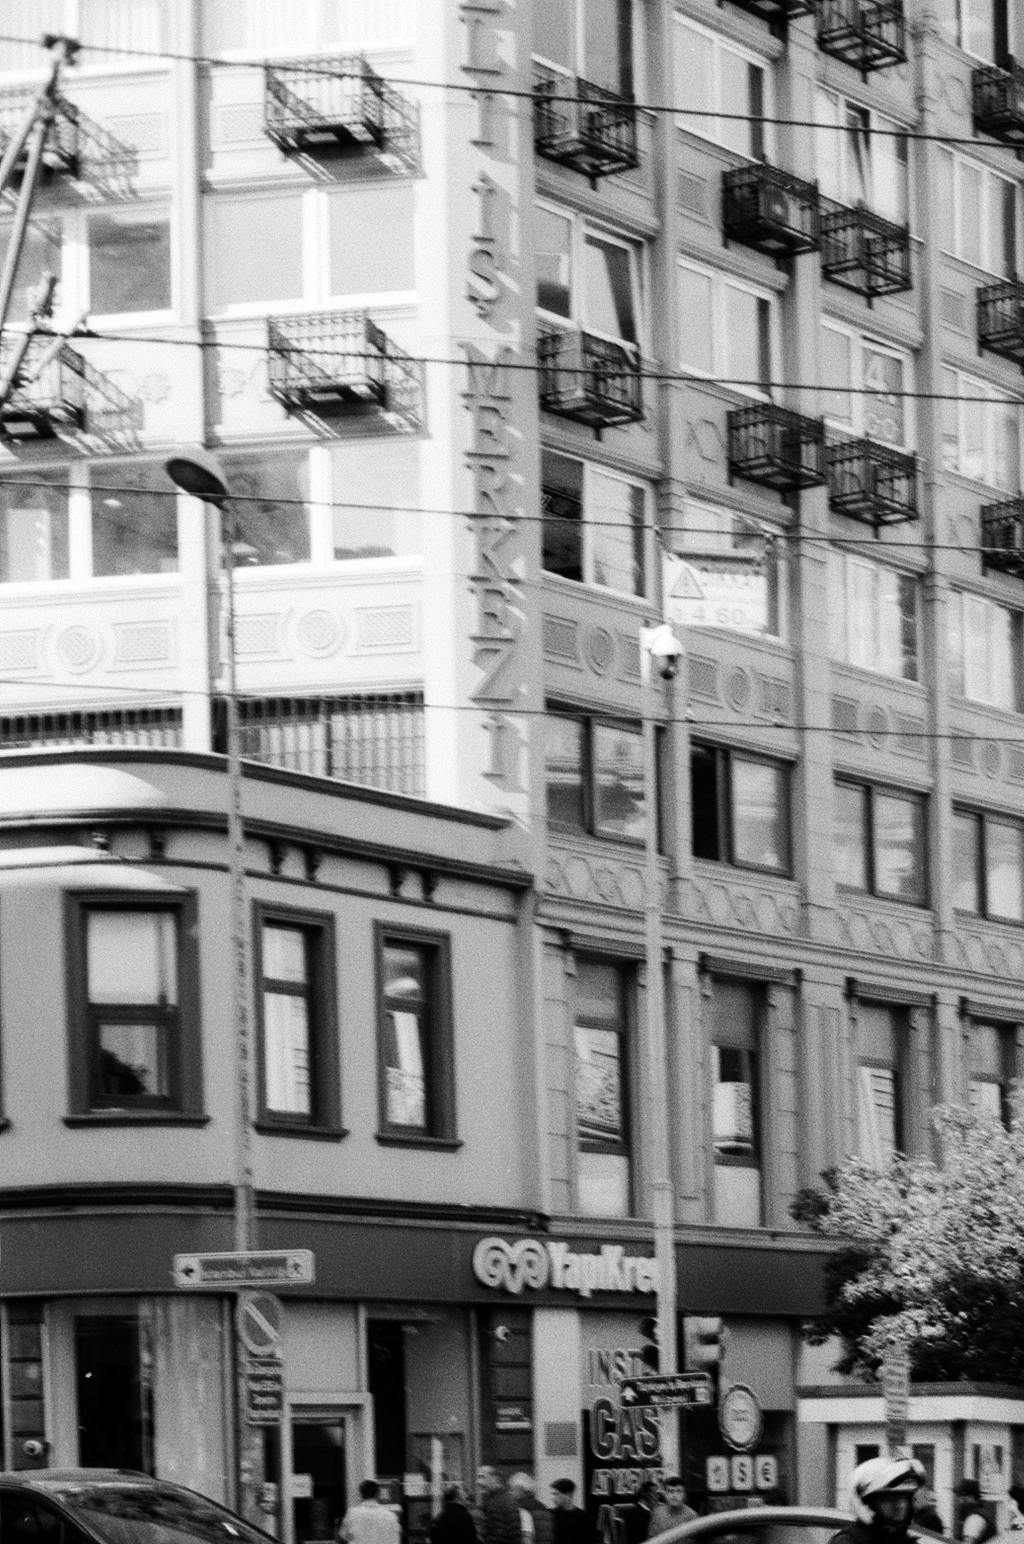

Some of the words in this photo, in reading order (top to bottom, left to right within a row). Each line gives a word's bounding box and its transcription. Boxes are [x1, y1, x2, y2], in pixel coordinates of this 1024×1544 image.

[457, 342, 517, 778] MERKEZİ
[547, 1242, 658, 1298] YapıKre
[590, 1396, 660, 1460] CAS
